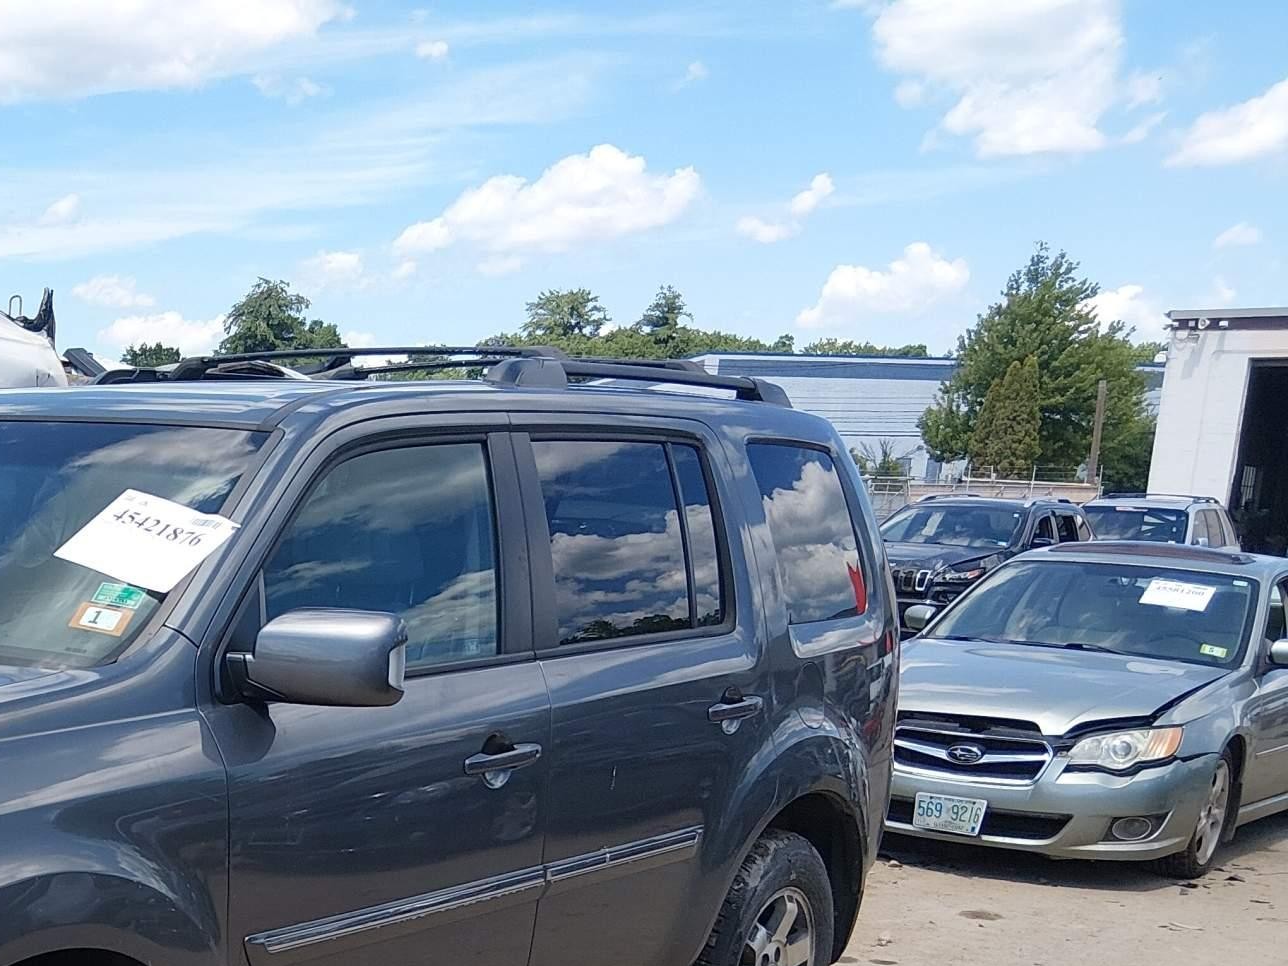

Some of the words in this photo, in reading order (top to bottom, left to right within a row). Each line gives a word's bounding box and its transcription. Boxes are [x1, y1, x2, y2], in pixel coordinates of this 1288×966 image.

[112, 508, 207, 547] 45421876
[87, 610, 103, 625] 1
[917, 800, 943, 819] 569
[951, 804, 983, 824] 9216
